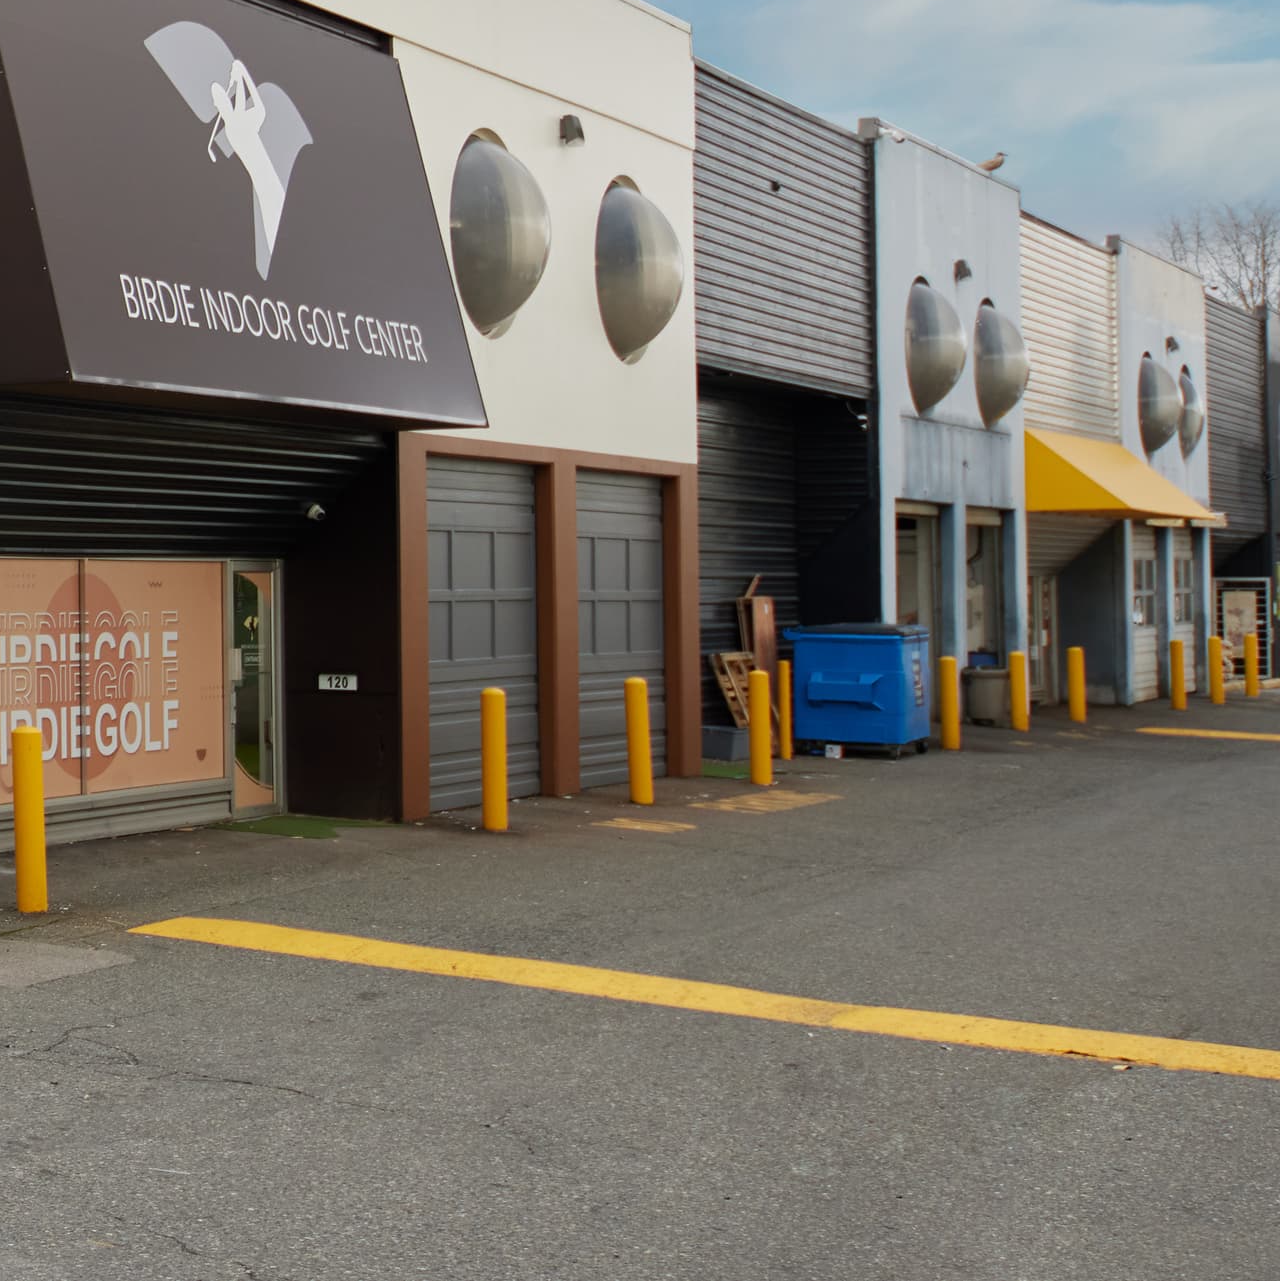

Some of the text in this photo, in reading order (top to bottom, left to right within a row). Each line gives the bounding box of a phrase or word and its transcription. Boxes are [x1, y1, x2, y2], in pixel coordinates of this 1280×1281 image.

[120, 274, 428, 363] BIRDIE INDOOR GOLF CENTER
[327, 676, 348, 689] 120
